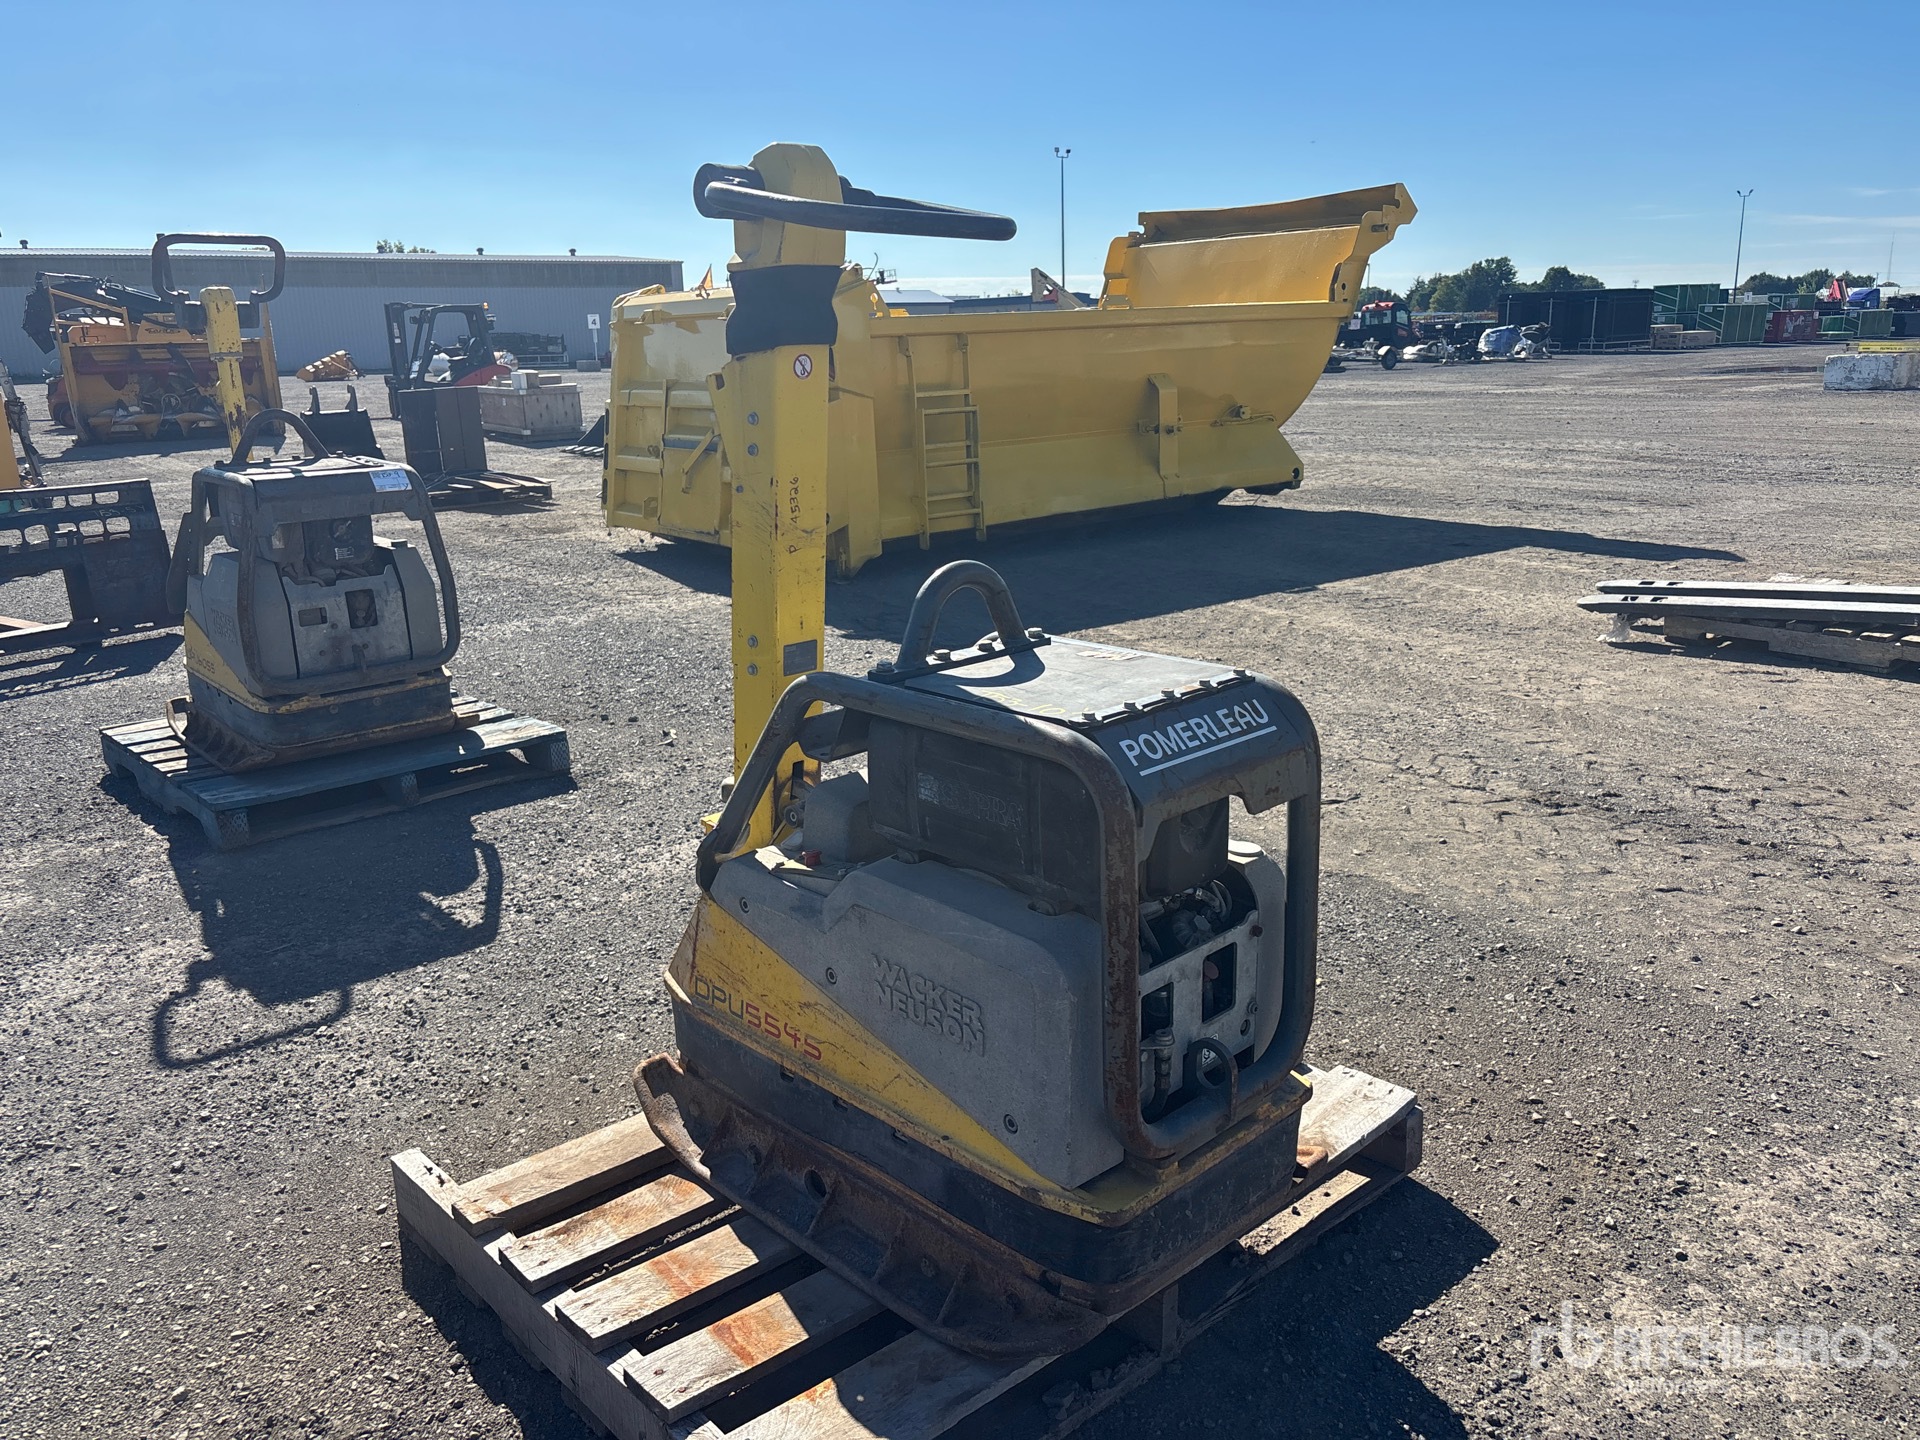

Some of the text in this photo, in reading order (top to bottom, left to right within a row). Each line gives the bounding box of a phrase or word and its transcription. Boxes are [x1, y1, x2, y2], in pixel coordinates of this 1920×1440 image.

[591, 318, 597, 326] 4
[1119, 699, 1269, 767] POMERLEAU
[694, 975, 822, 1061] DPU5545
[871, 953, 985, 1031] WACKER
[874, 980, 985, 1058] NEUSON
